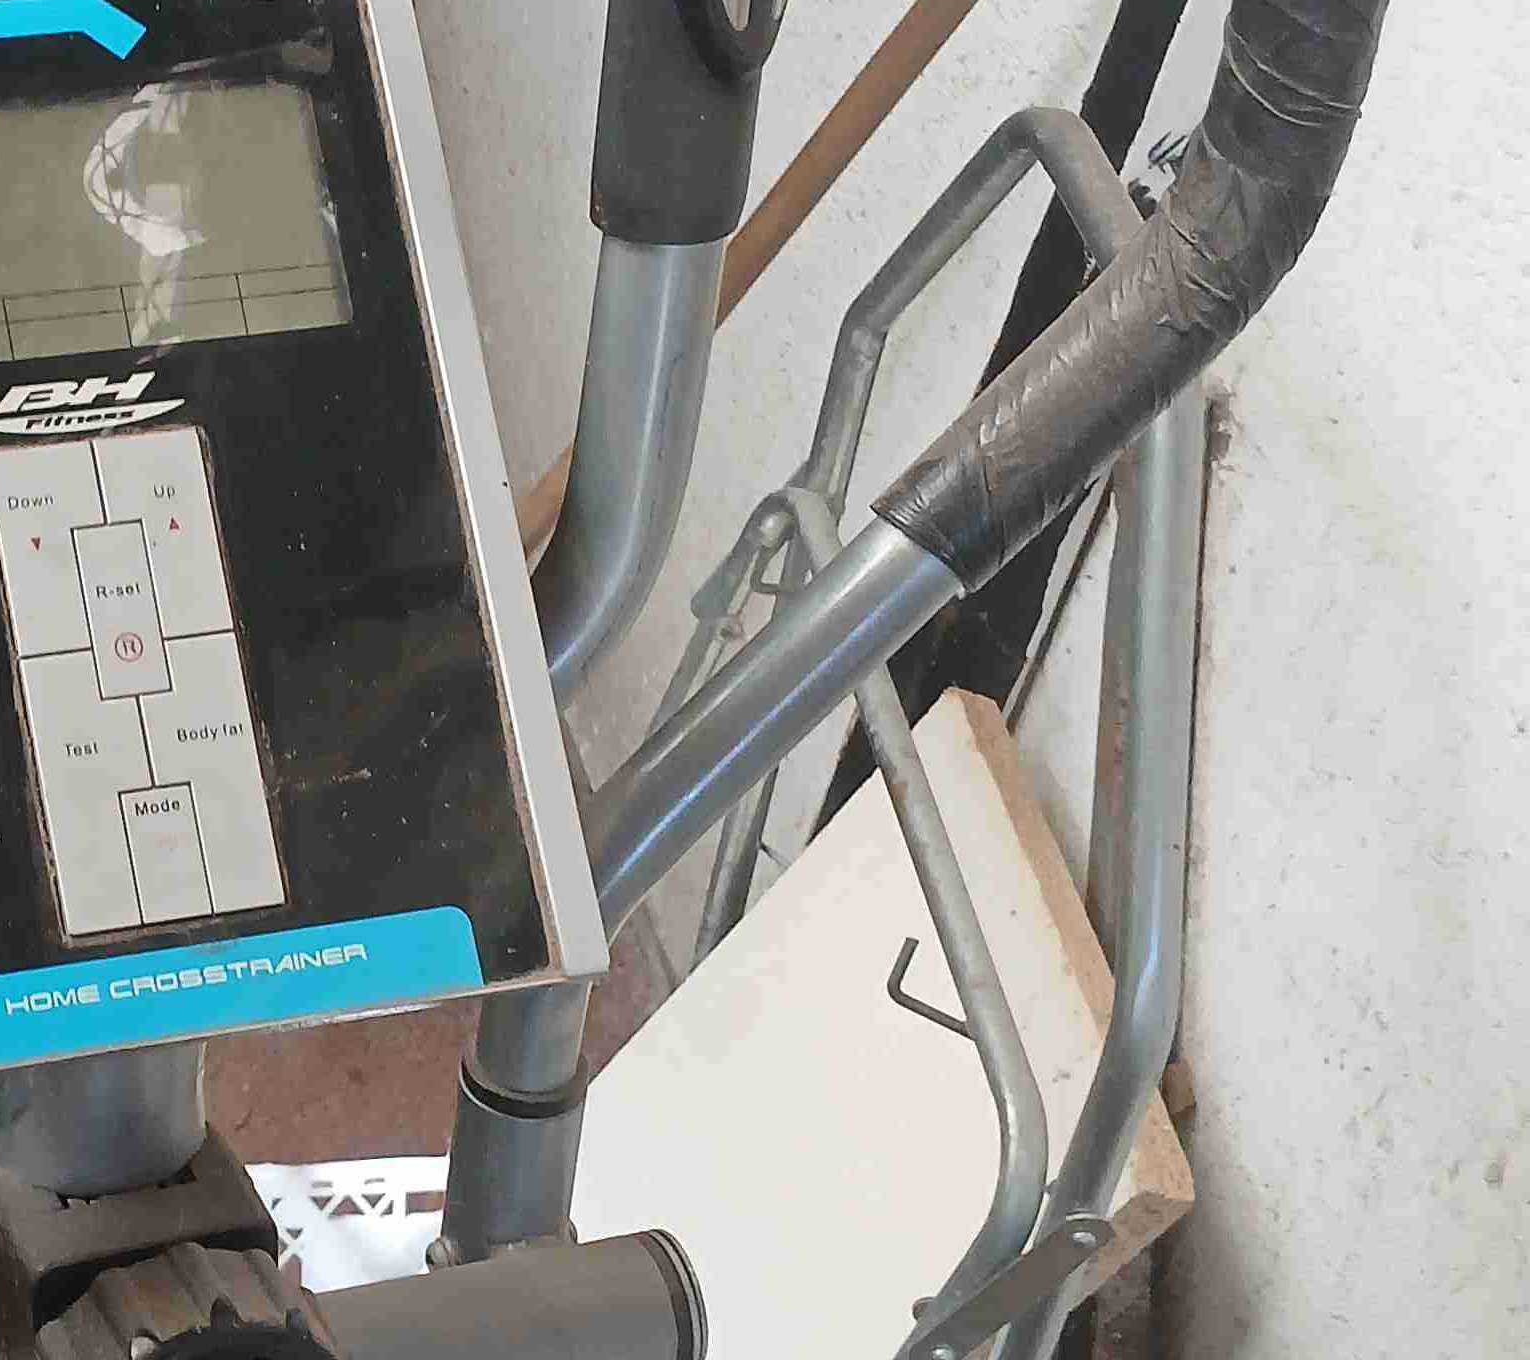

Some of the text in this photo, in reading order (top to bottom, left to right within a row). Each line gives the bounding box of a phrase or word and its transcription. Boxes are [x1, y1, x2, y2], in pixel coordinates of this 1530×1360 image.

[24, 408, 137, 431] Fitness
[152, 483, 176, 501] Up
[6, 493, 55, 511] Down
[176, 723, 219, 745] Body
[64, 741, 100, 758] Test
[133, 797, 181, 816] Mode
[4, 942, 369, 1016] HOME CROSSTRAINER
